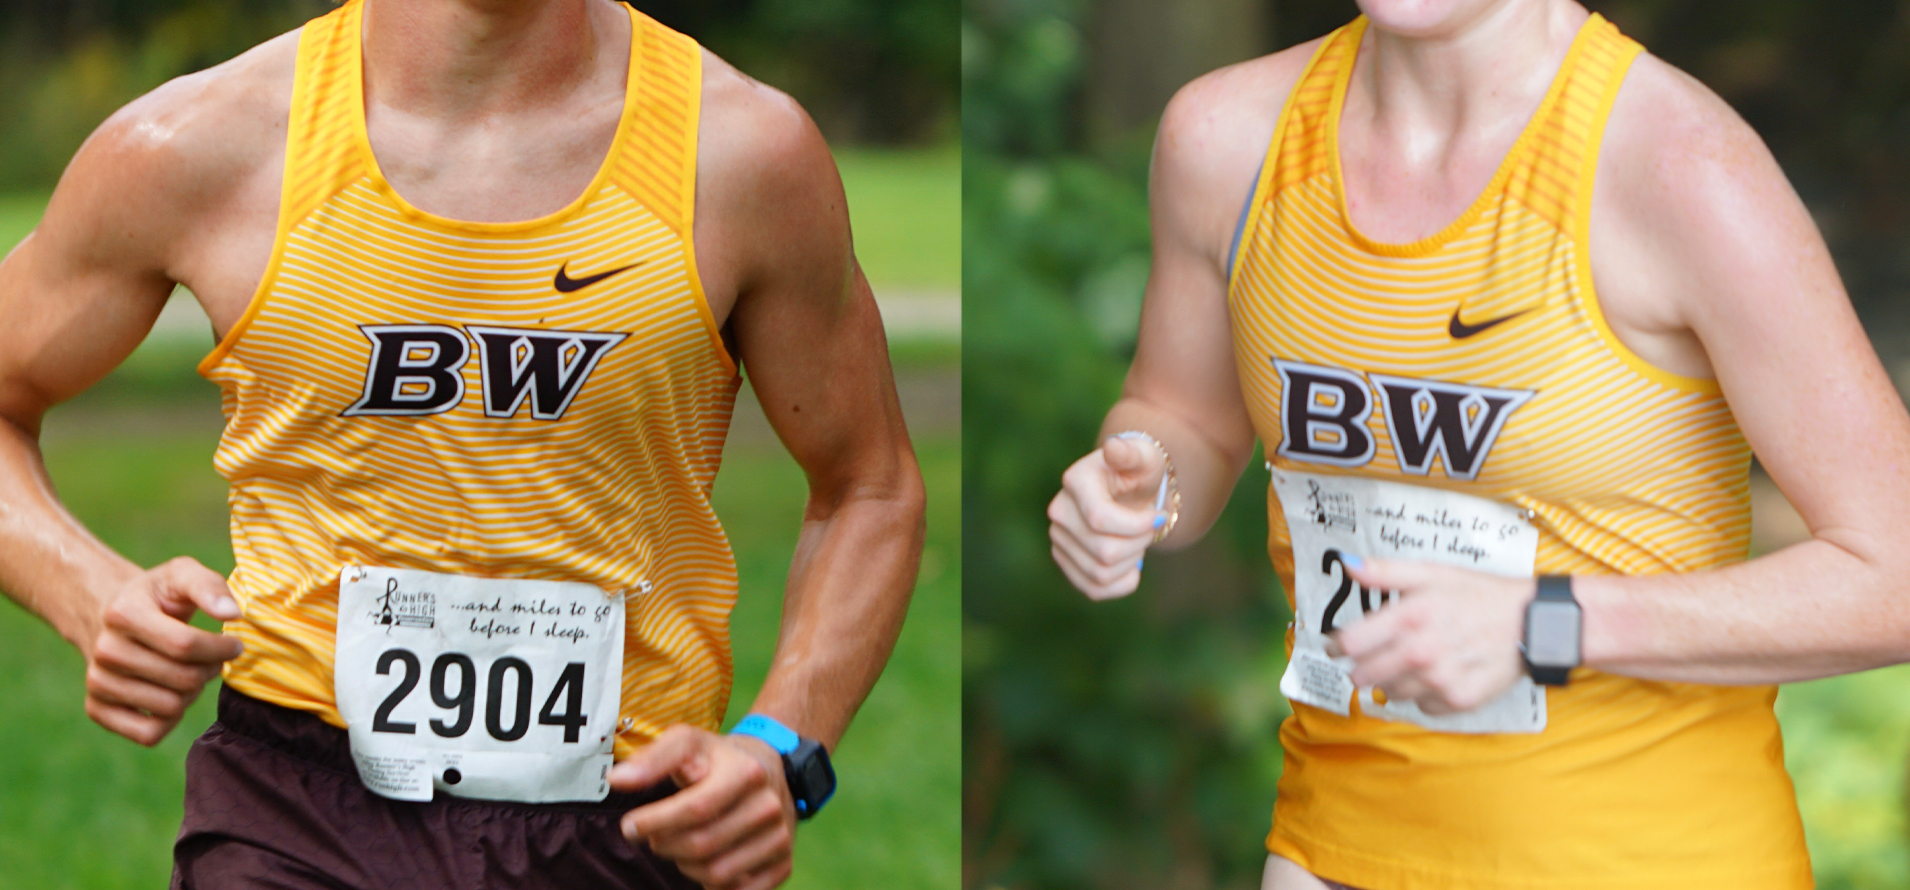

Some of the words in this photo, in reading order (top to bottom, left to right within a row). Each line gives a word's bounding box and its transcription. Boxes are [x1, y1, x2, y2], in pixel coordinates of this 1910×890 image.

[338, 324, 633, 421] BW
[1271, 357, 1538, 481] BW
[1416, 509, 1461, 529] miles
[1473, 516, 1489, 526] to
[1381, 524, 1424, 550] before
[410, 604, 435, 615] HIGH
[510, 599, 560, 615] miles
[570, 601, 586, 616] to
[594, 605, 611, 622] go
[469, 617, 520, 639] before
[529, 620, 536, 635] I
[544, 621, 589, 644] sleep.
[371, 647, 587, 743] 2904
